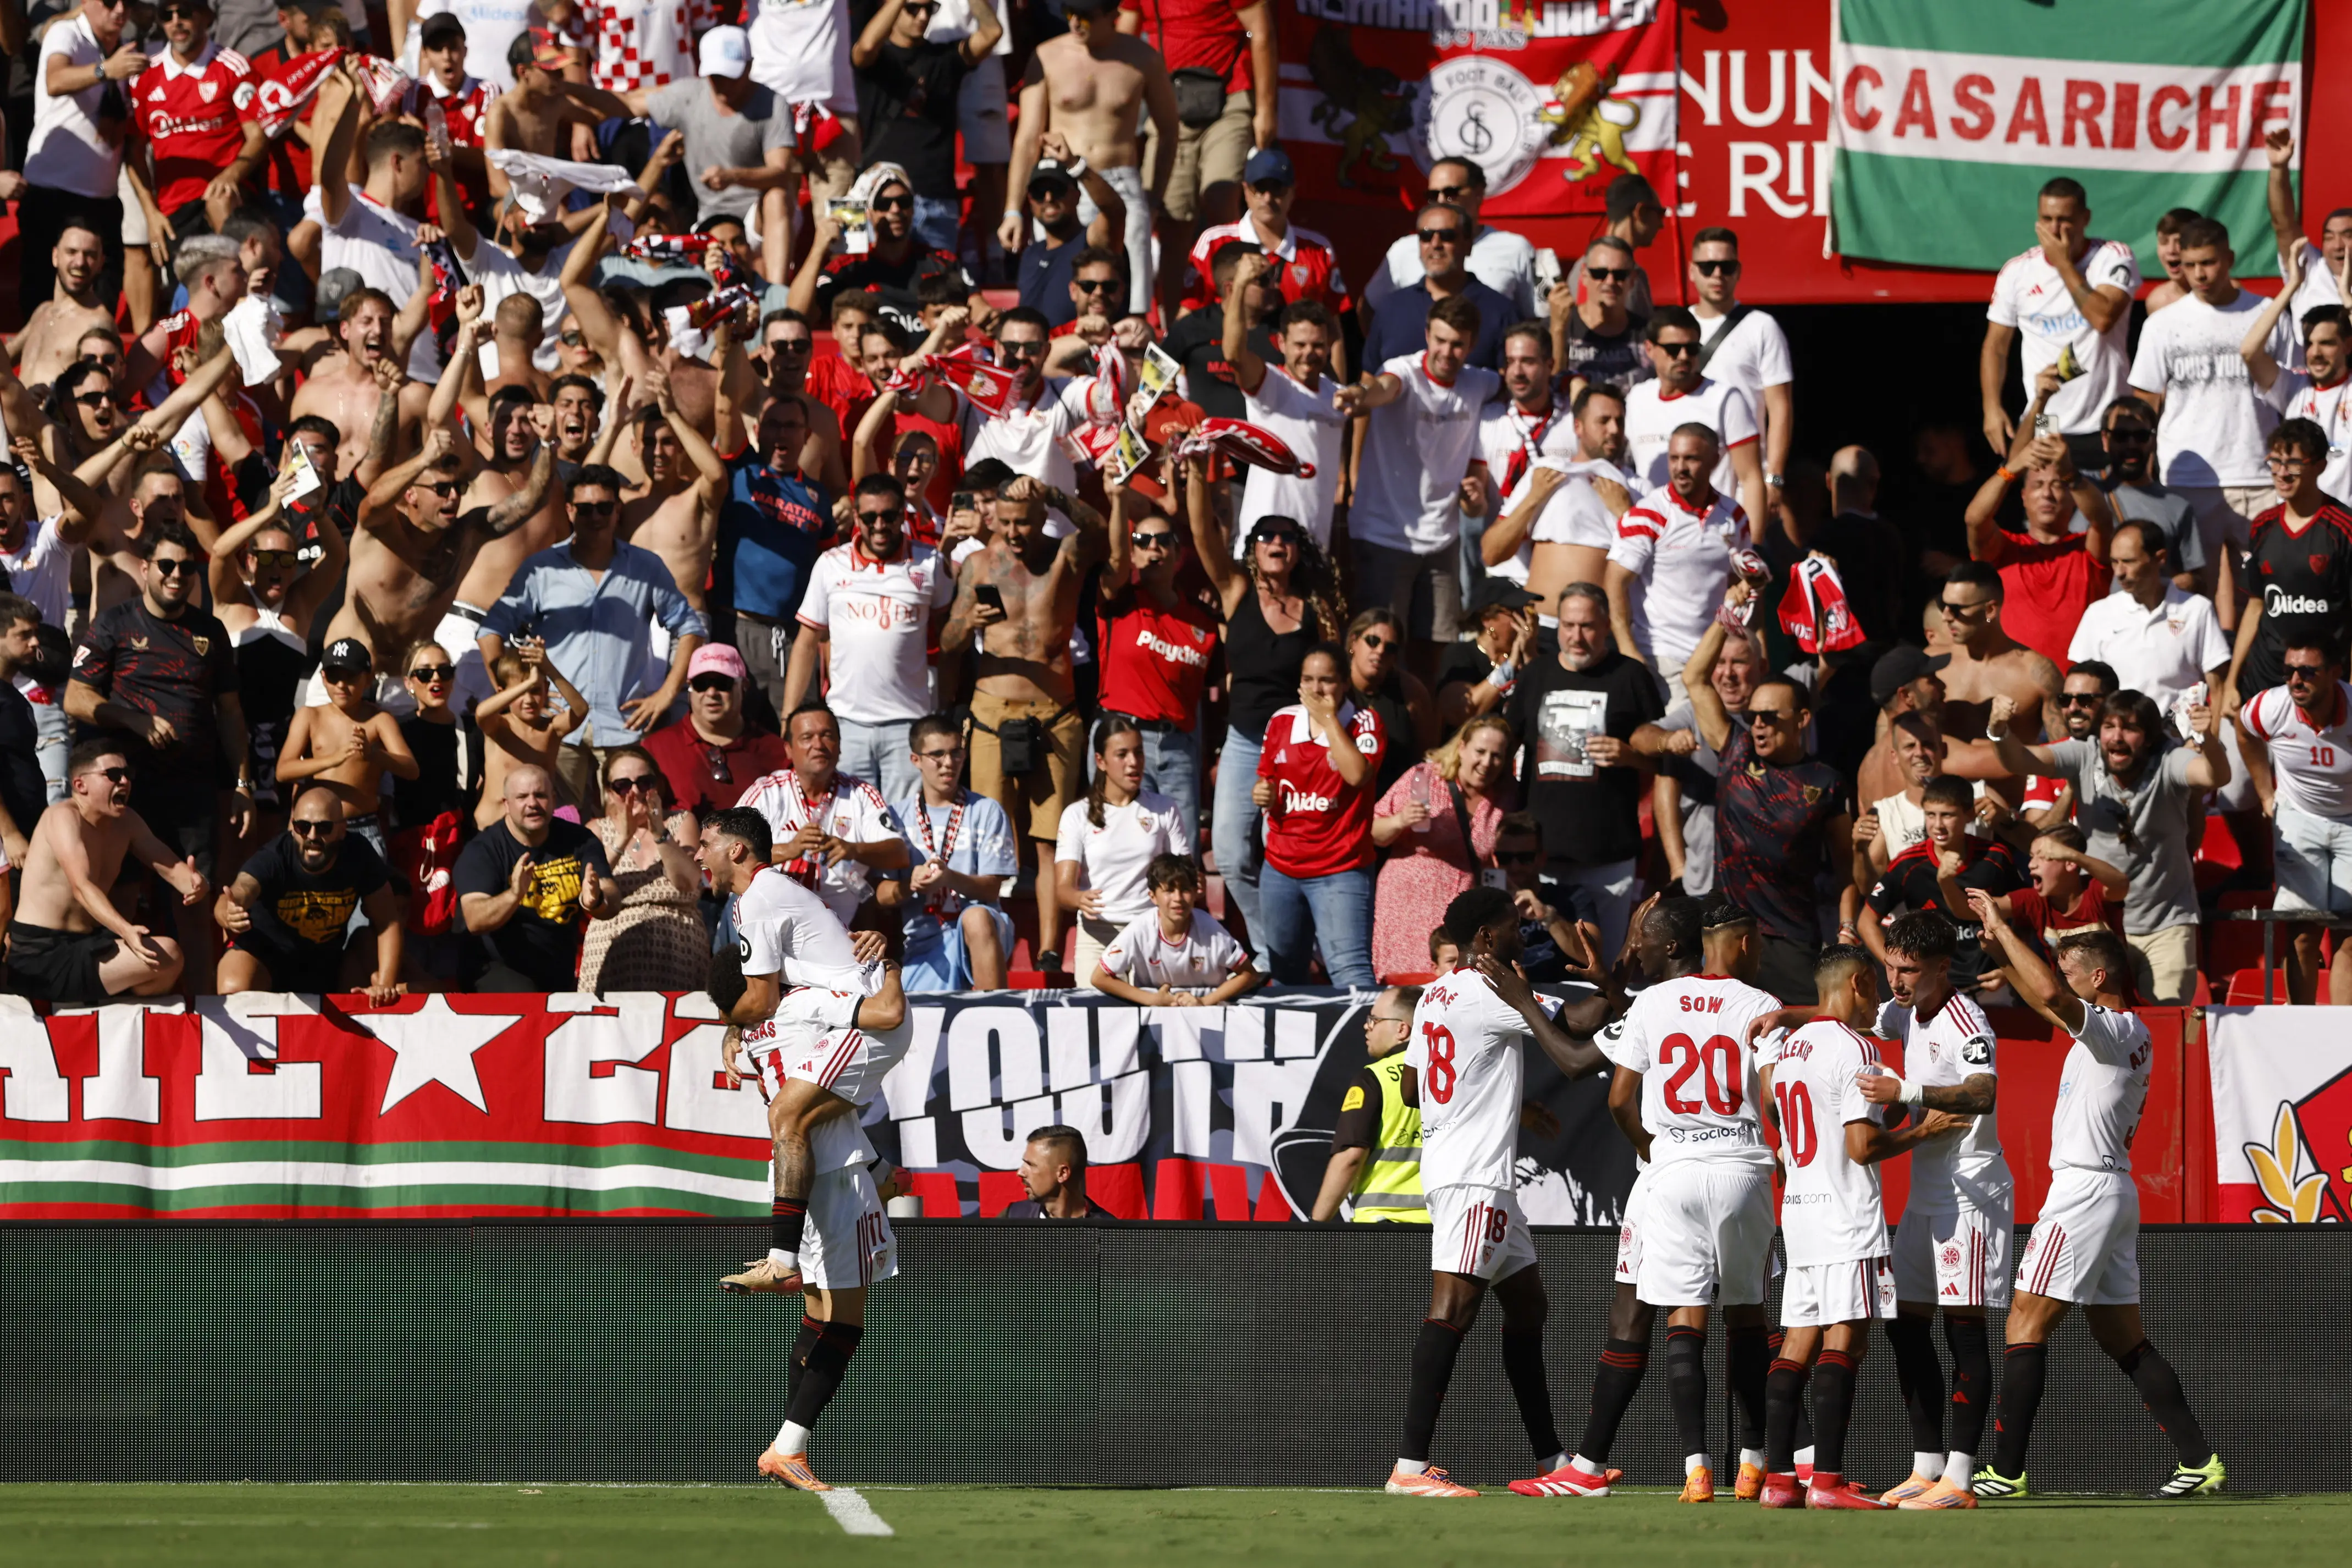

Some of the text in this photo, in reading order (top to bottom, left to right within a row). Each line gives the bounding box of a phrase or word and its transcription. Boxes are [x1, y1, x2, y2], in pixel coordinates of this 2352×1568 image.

[1843, 64, 2290, 152] CASARICHE
[2265, 587, 2328, 617] Midea
[1135, 630, 1208, 669] Playtika
[2309, 746, 2334, 767] 10
[1679, 995, 1724, 1014] SOW
[1422, 1020, 1457, 1105] 18
[1775, 1039, 1813, 1065] ALEXIS
[881, 1004, 1318, 1171] YOUTH
[1659, 1032, 1743, 1116] 20
[1775, 1080, 1818, 1168] 10
[867, 1211, 887, 1246] 11
[1483, 1206, 1507, 1243] 18
